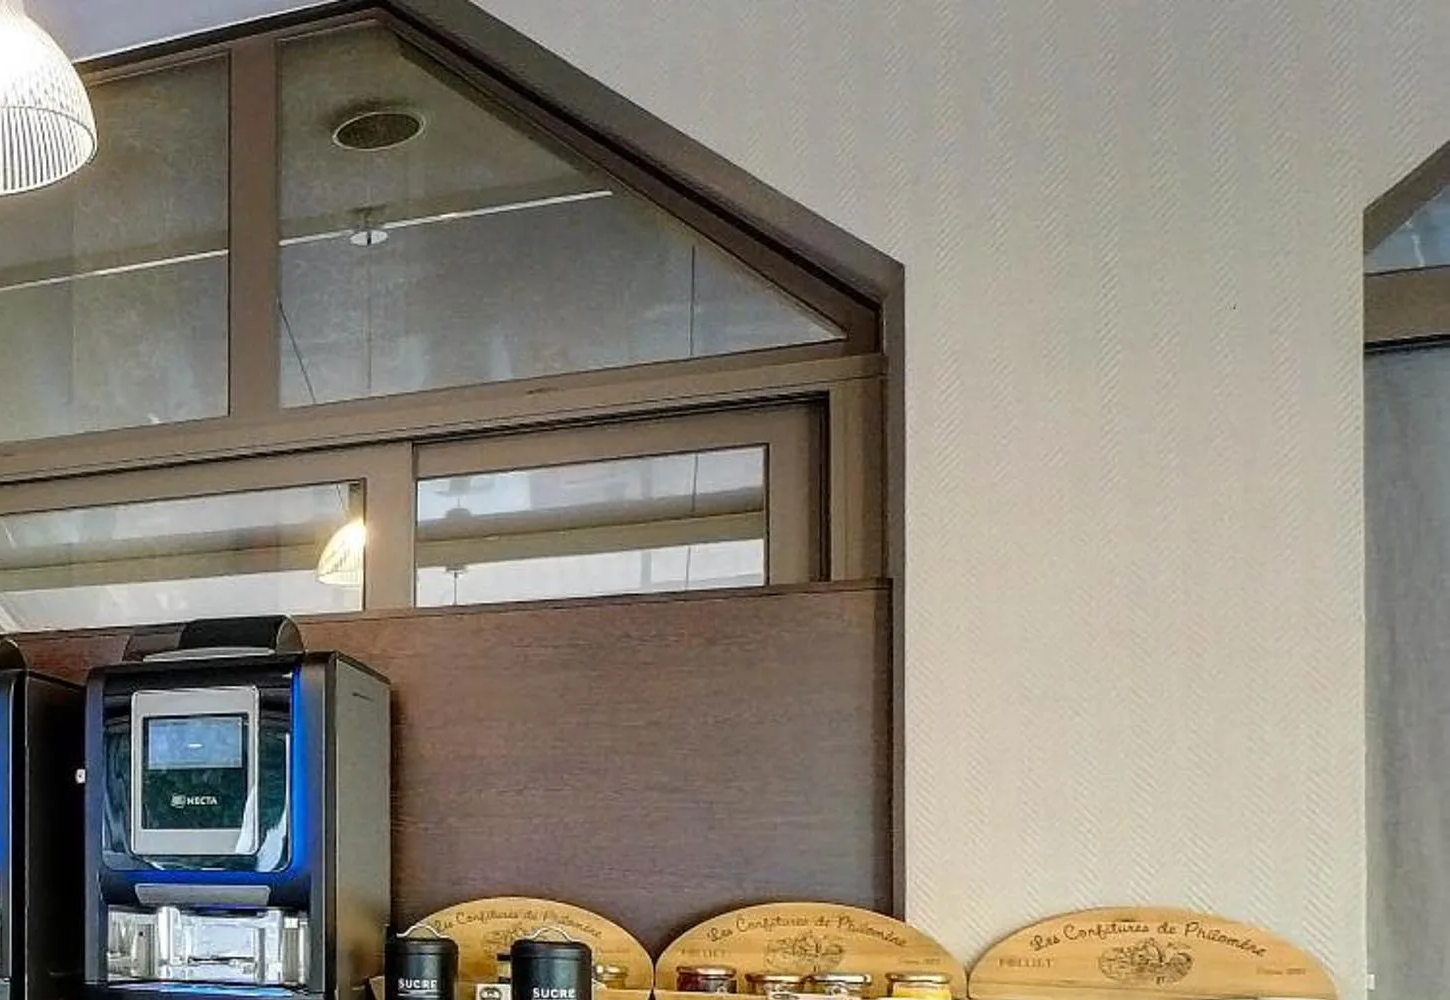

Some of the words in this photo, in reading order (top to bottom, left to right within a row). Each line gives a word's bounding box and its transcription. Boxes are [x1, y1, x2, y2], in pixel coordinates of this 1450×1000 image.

[186, 796, 218, 806] NECTA
[707, 927, 734, 943] Les
[736, 914, 808, 933] Confitures
[1030, 934, 1061, 952] Les
[1063, 922, 1150, 941] Confitures
[1157, 921, 1177, 935] de
[397, 977, 439, 990] SUCRE
[532, 986, 577, 1000] SUCRE
